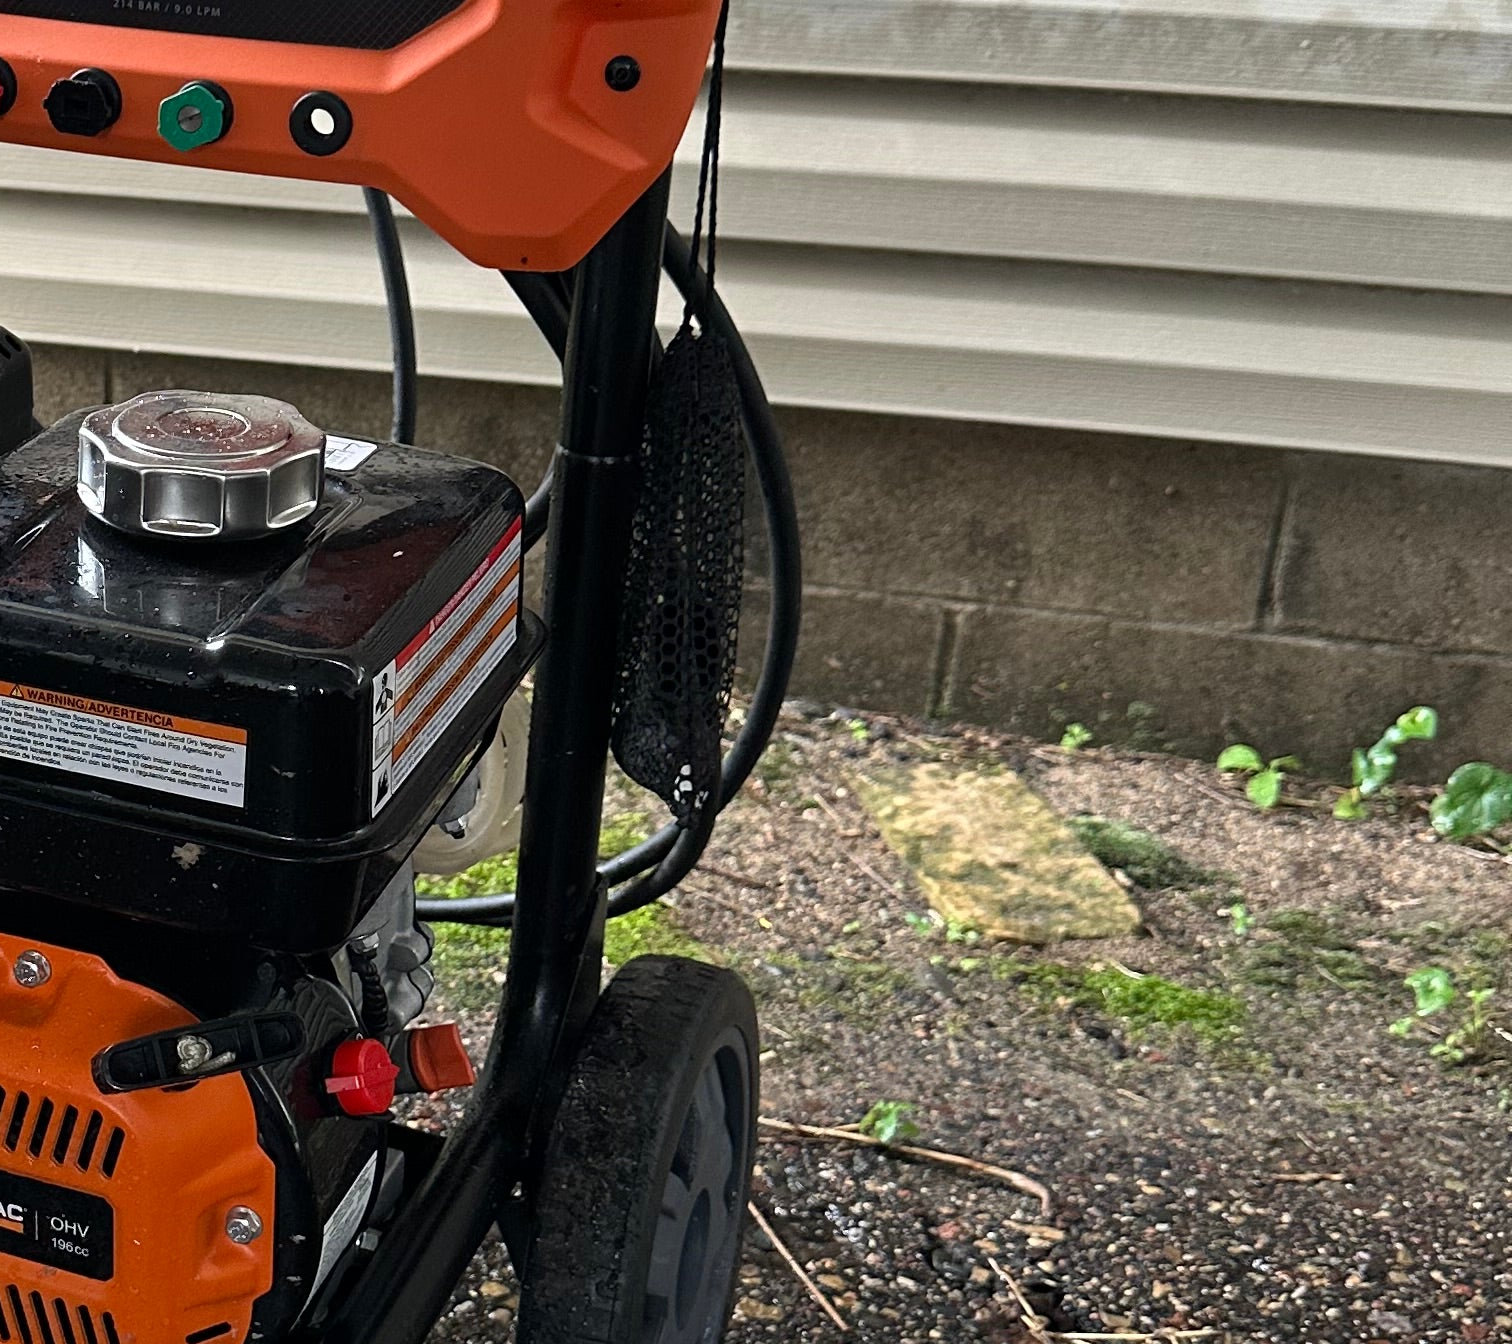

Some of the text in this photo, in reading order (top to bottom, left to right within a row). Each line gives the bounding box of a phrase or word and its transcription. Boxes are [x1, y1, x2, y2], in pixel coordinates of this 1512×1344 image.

[138, 0, 160, 12] BAR
[174, 3, 192, 15] 9.0
[196, 5, 221, 16] LPM
[26, 688, 174, 728] WARNING/ADVERTENCIA
[50, 1216, 90, 1238] OHV
